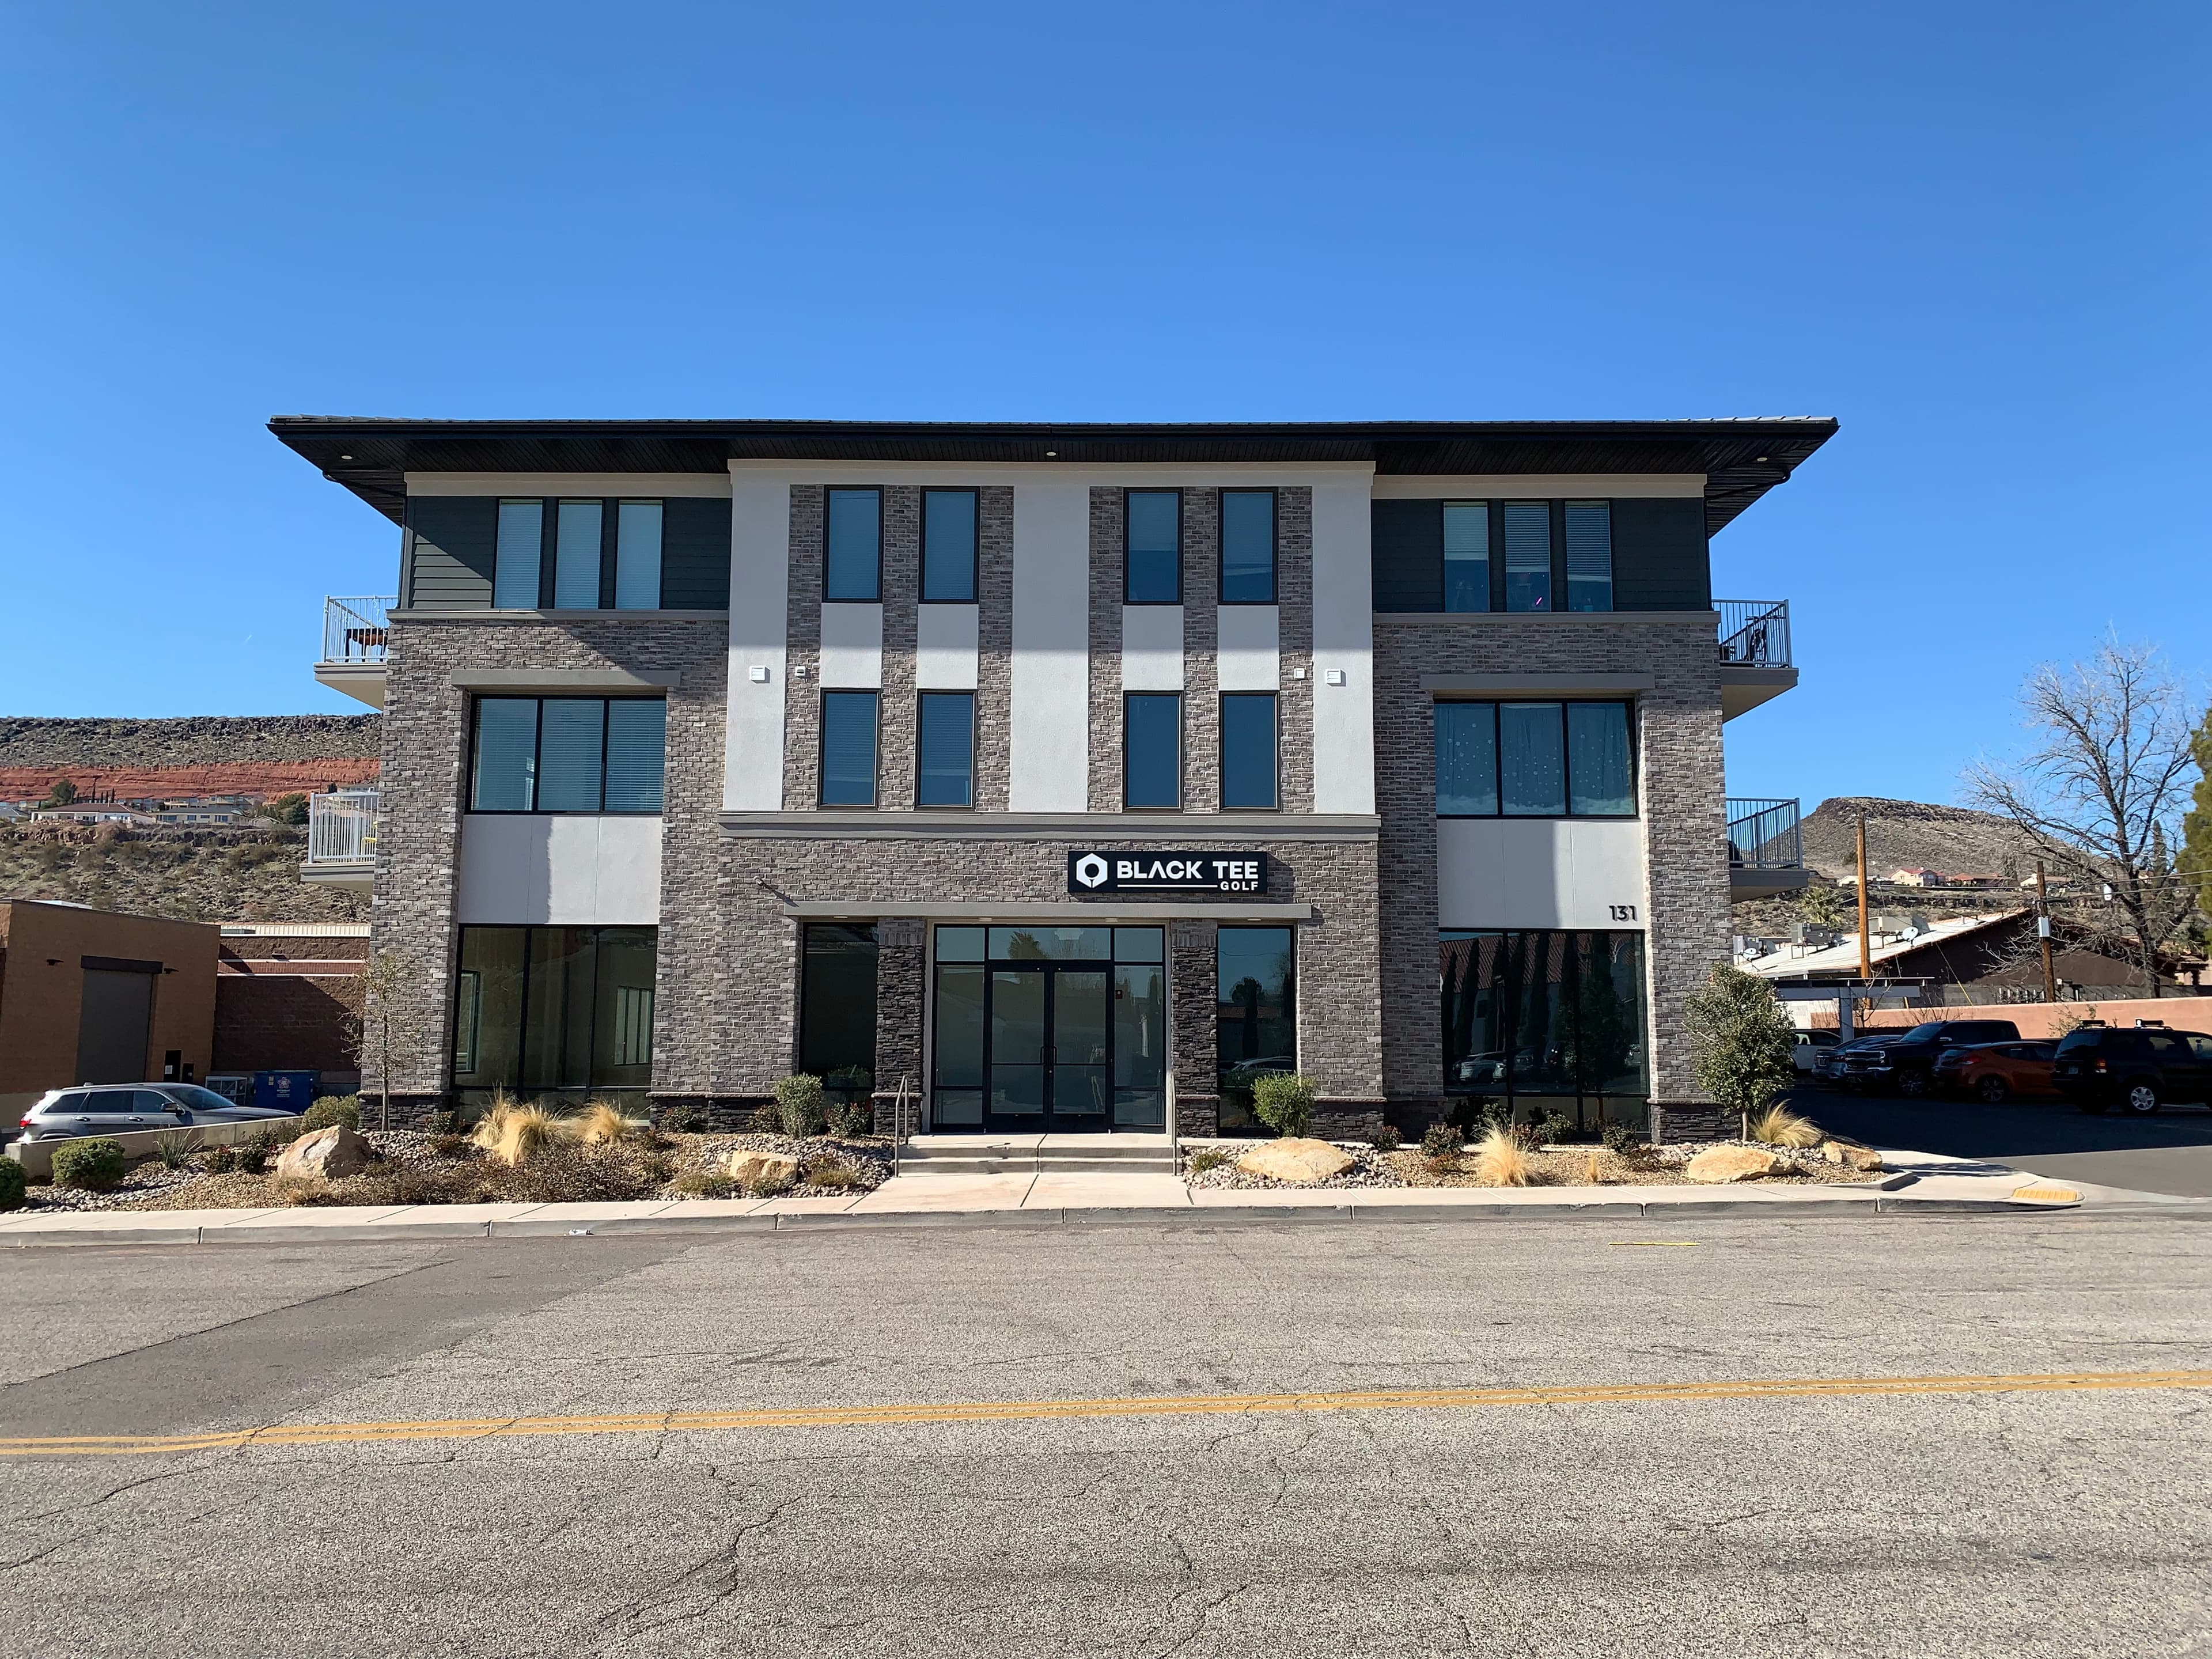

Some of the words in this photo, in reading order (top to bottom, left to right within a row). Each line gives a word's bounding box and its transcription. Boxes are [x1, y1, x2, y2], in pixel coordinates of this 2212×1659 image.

[1117, 860, 1203, 879] BLACK
[1213, 861, 1259, 879] TEE
[1220, 881, 1259, 891] GOLF
[1608, 905, 1637, 922] 131
